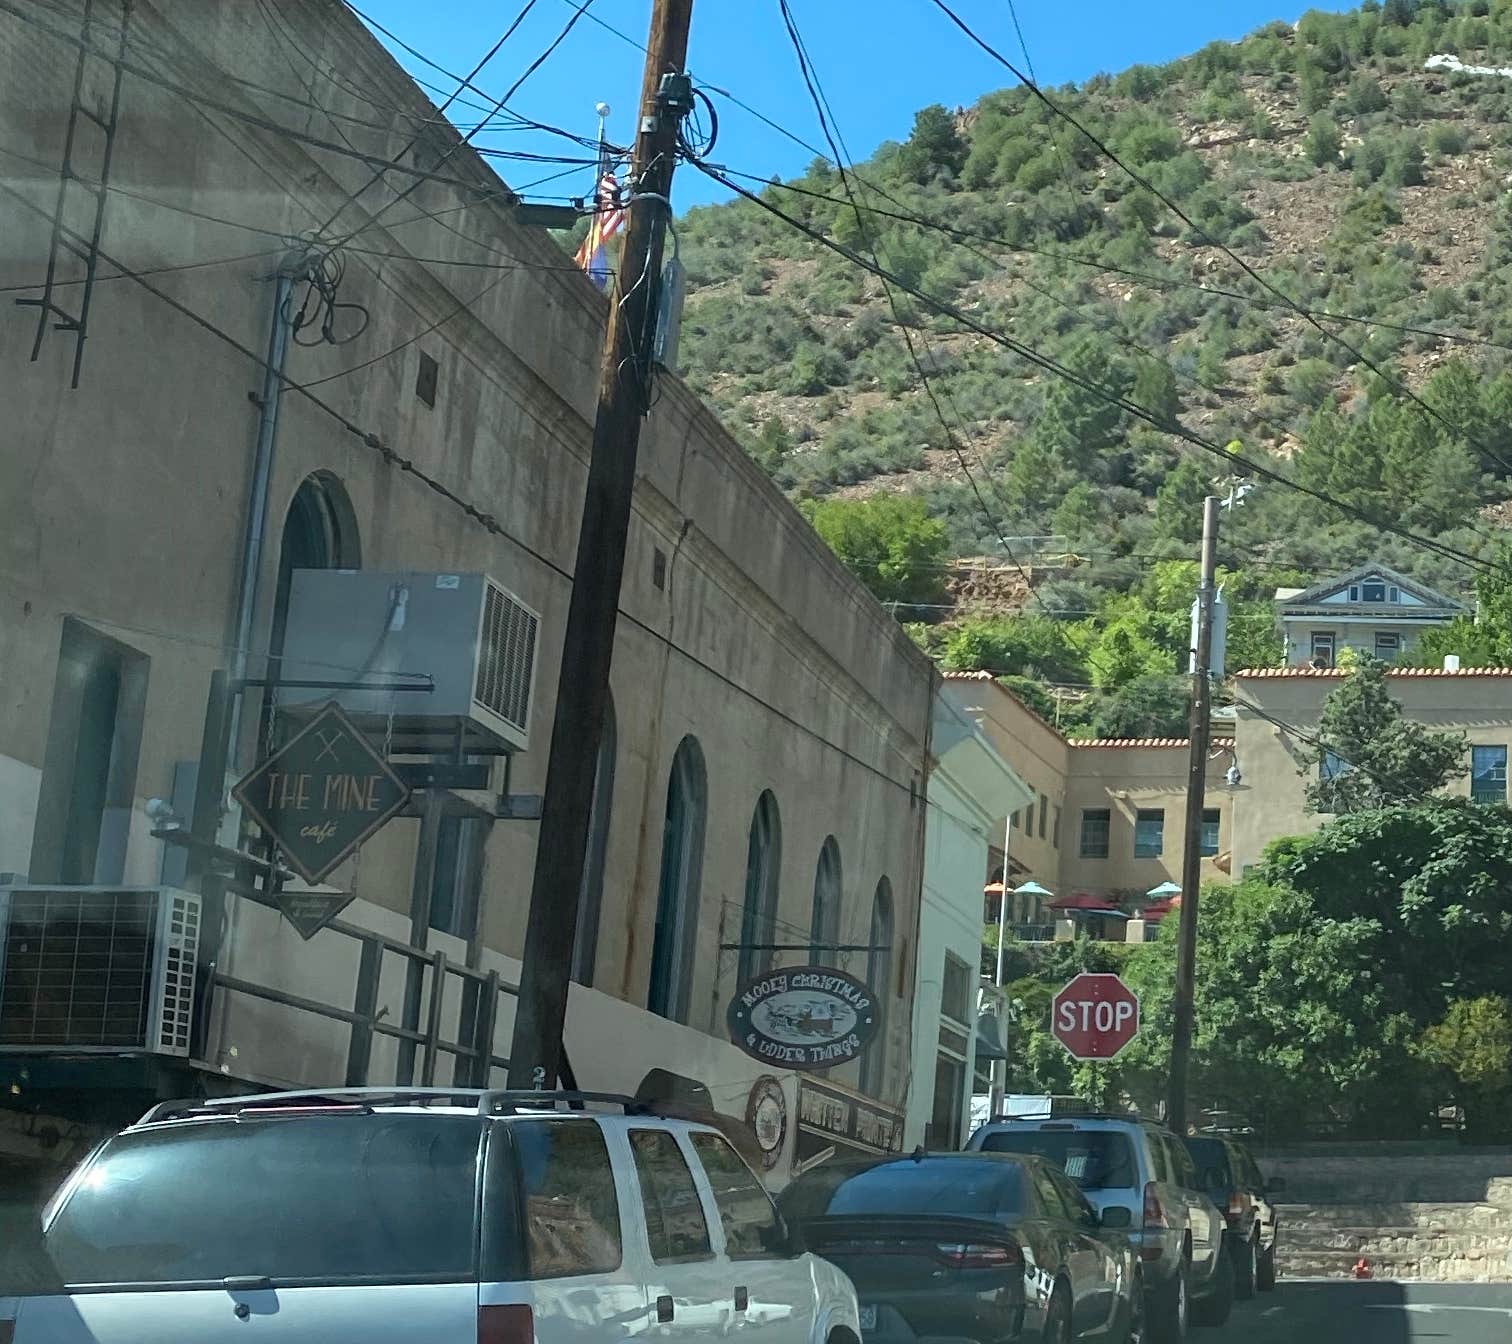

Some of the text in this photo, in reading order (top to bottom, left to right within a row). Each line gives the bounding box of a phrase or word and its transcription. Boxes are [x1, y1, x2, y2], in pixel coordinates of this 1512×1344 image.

[267, 773, 384, 811] THE MINE
[741, 973, 870, 1010] MOOEY CHRISTMAS
[1058, 1000, 1133, 1032] STOP
